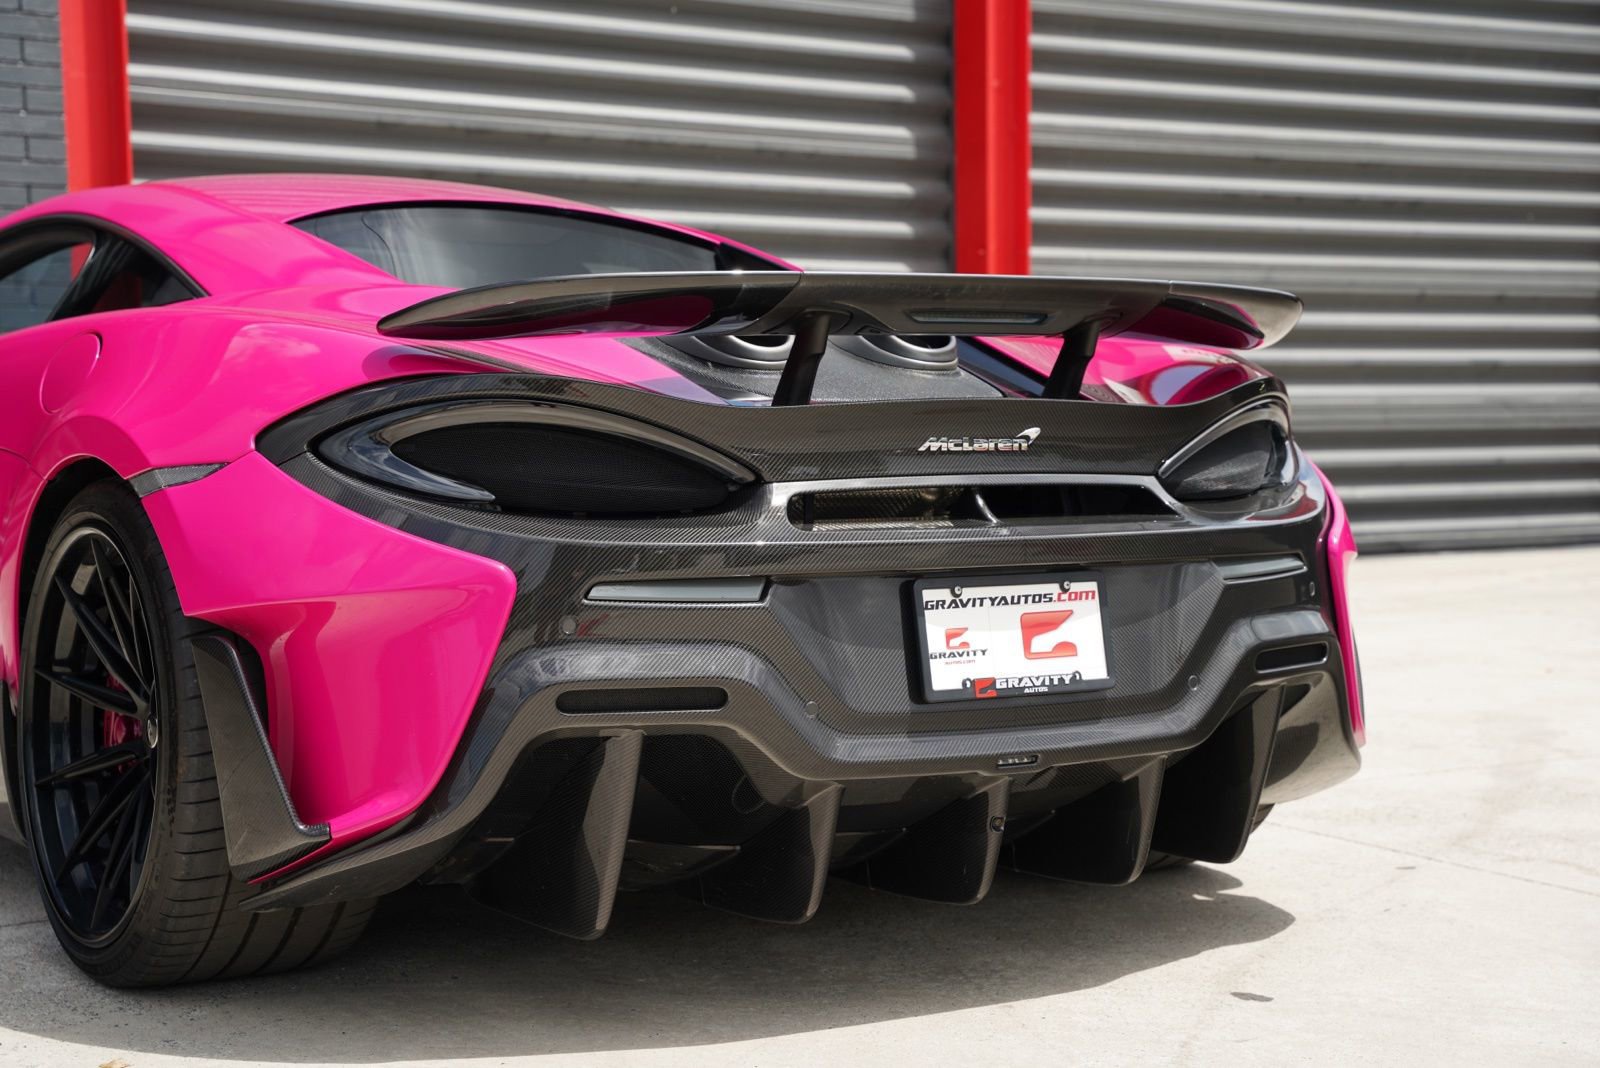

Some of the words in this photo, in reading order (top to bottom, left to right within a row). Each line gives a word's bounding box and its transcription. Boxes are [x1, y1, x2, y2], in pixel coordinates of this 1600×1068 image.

[917, 437, 1028, 452] McLaren
[929, 648, 988, 660] GRAVITY
[995, 674, 1073, 689] GRAVITY
[1023, 686, 1049, 694] AUTOS
